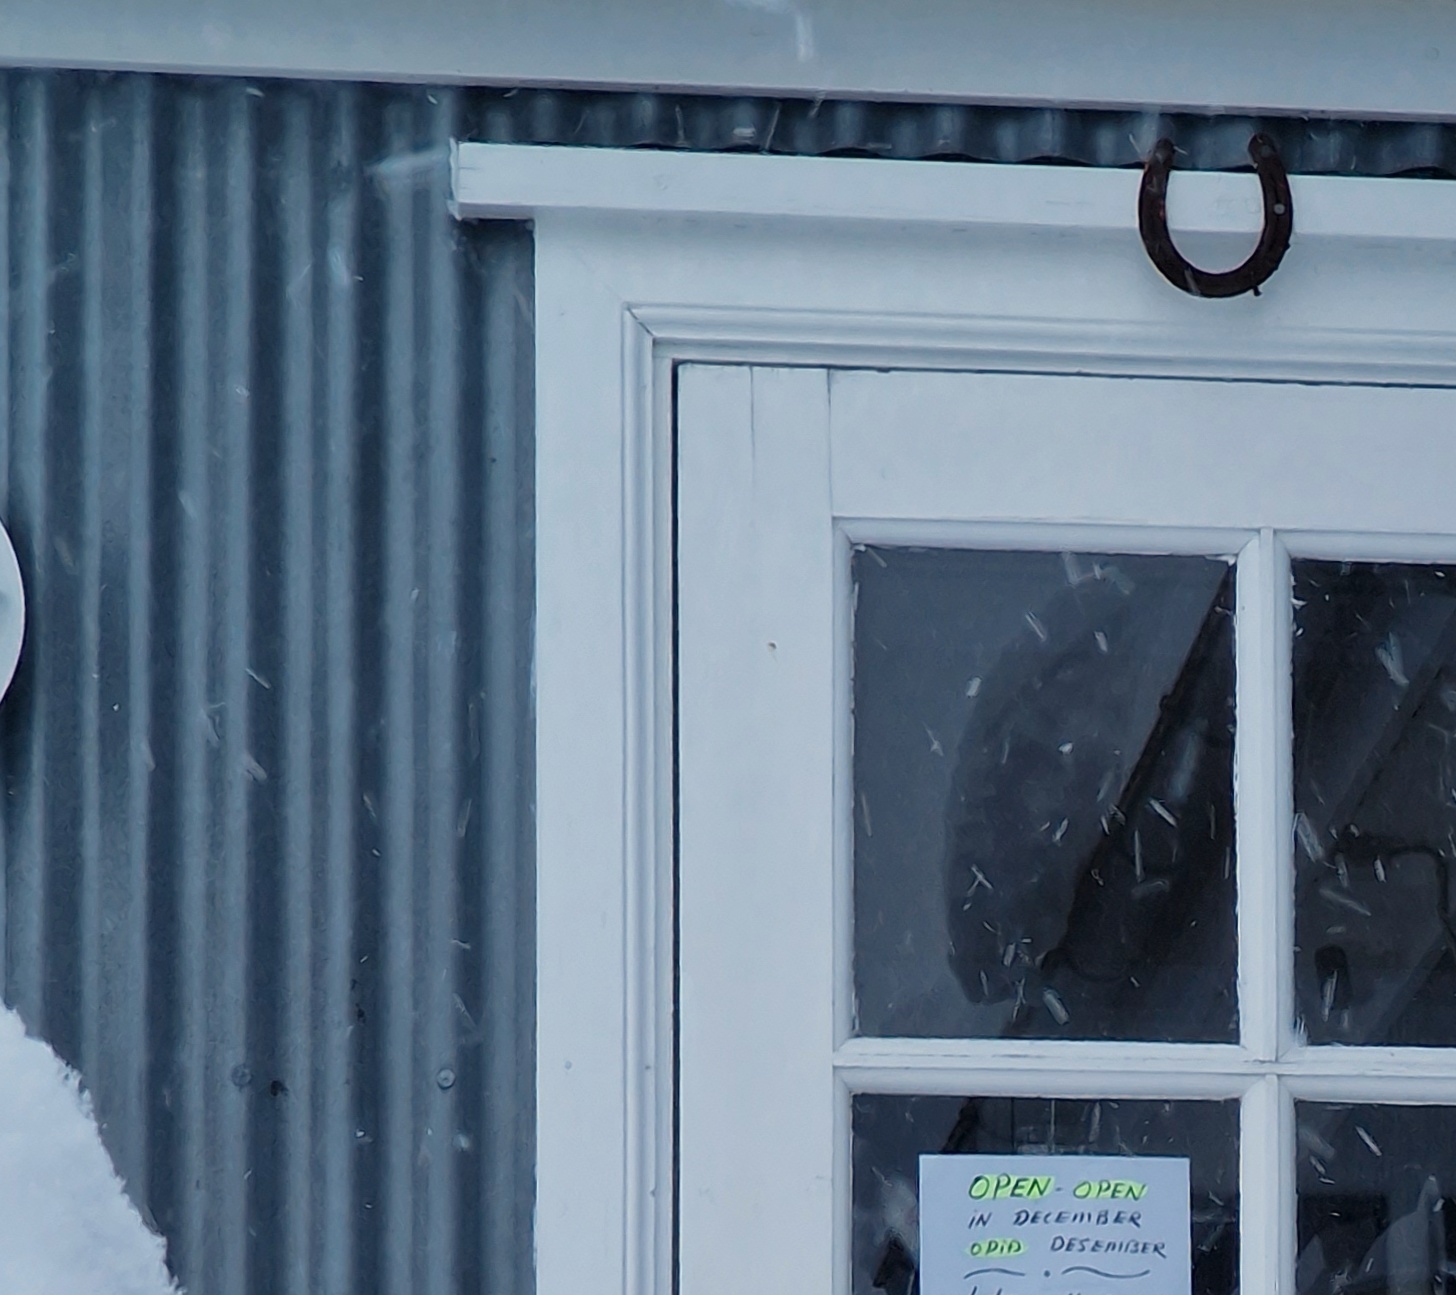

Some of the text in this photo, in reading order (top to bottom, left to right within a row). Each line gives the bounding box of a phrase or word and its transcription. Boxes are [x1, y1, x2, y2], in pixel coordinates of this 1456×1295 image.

[968, 1174, 1051, 1200] OPEN
[1073, 1180, 1146, 1201] OPEN
[1013, 1209, 1142, 1228] DECEMBER
[1050, 1235, 1167, 1259] DESEMBER
